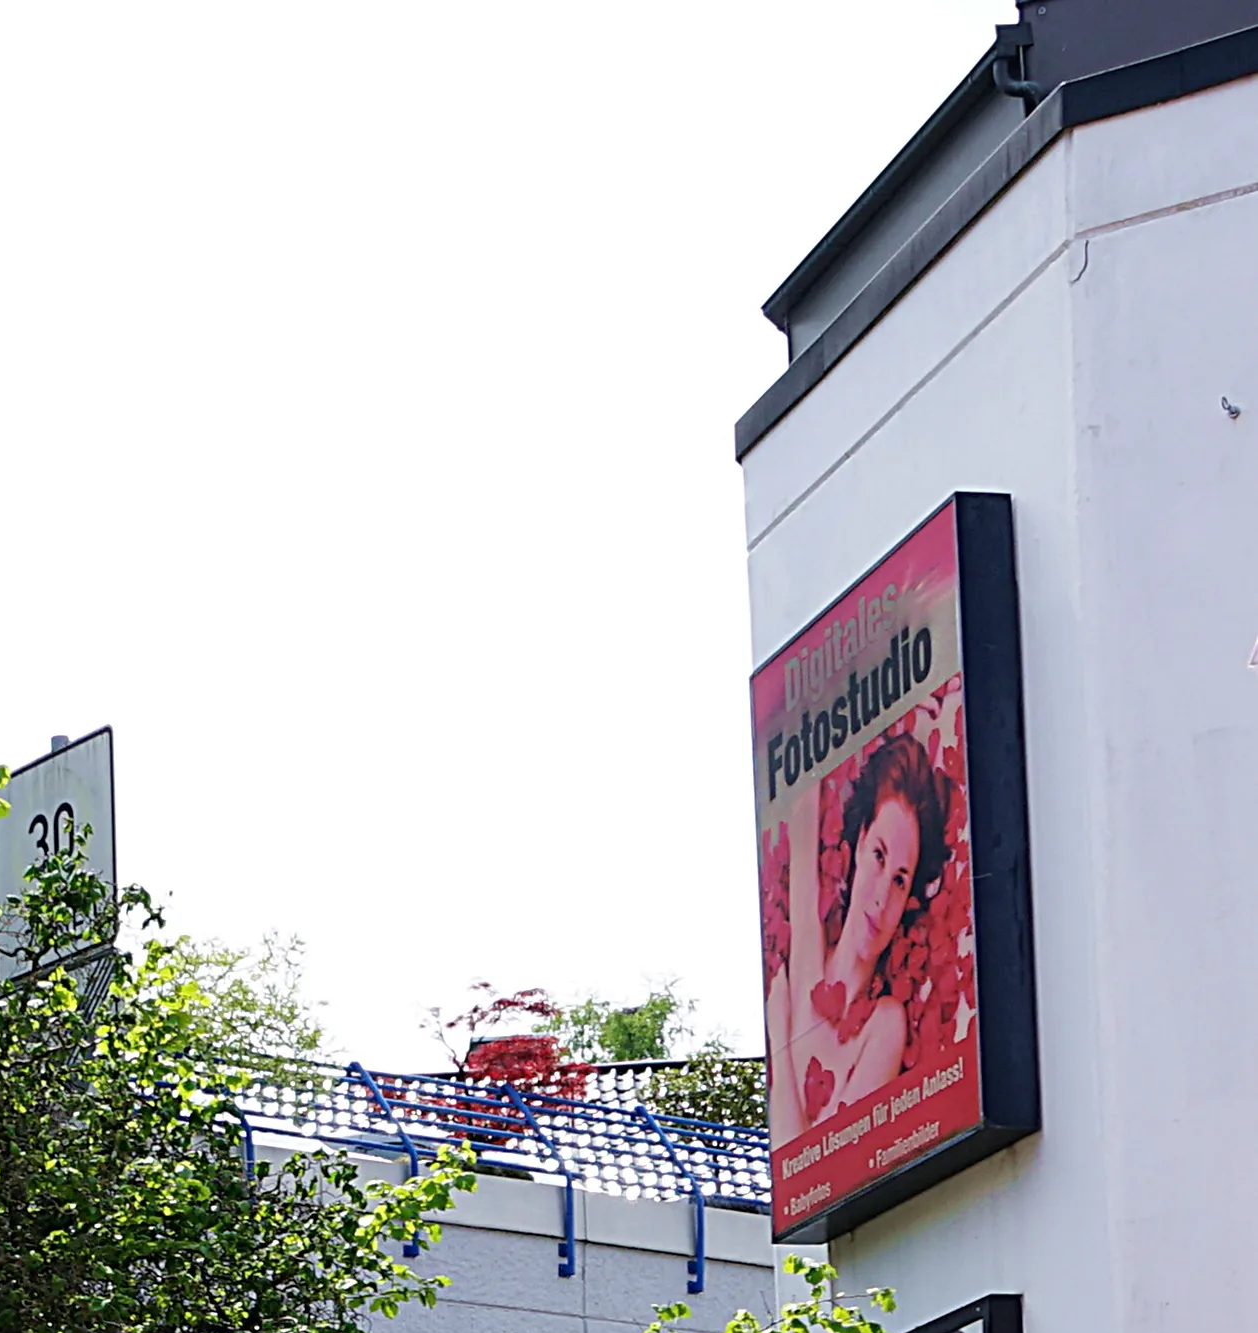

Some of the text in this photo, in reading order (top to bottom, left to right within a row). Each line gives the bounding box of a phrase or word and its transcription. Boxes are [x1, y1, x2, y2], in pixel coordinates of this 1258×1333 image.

[783, 583, 898, 713] Digitales
[767, 626, 932, 802] Fotostudio
[781, 1056, 964, 1180] Kreative Lösungen für jeden Anlass!
[875, 1120, 941, 1169] Familienbilder
